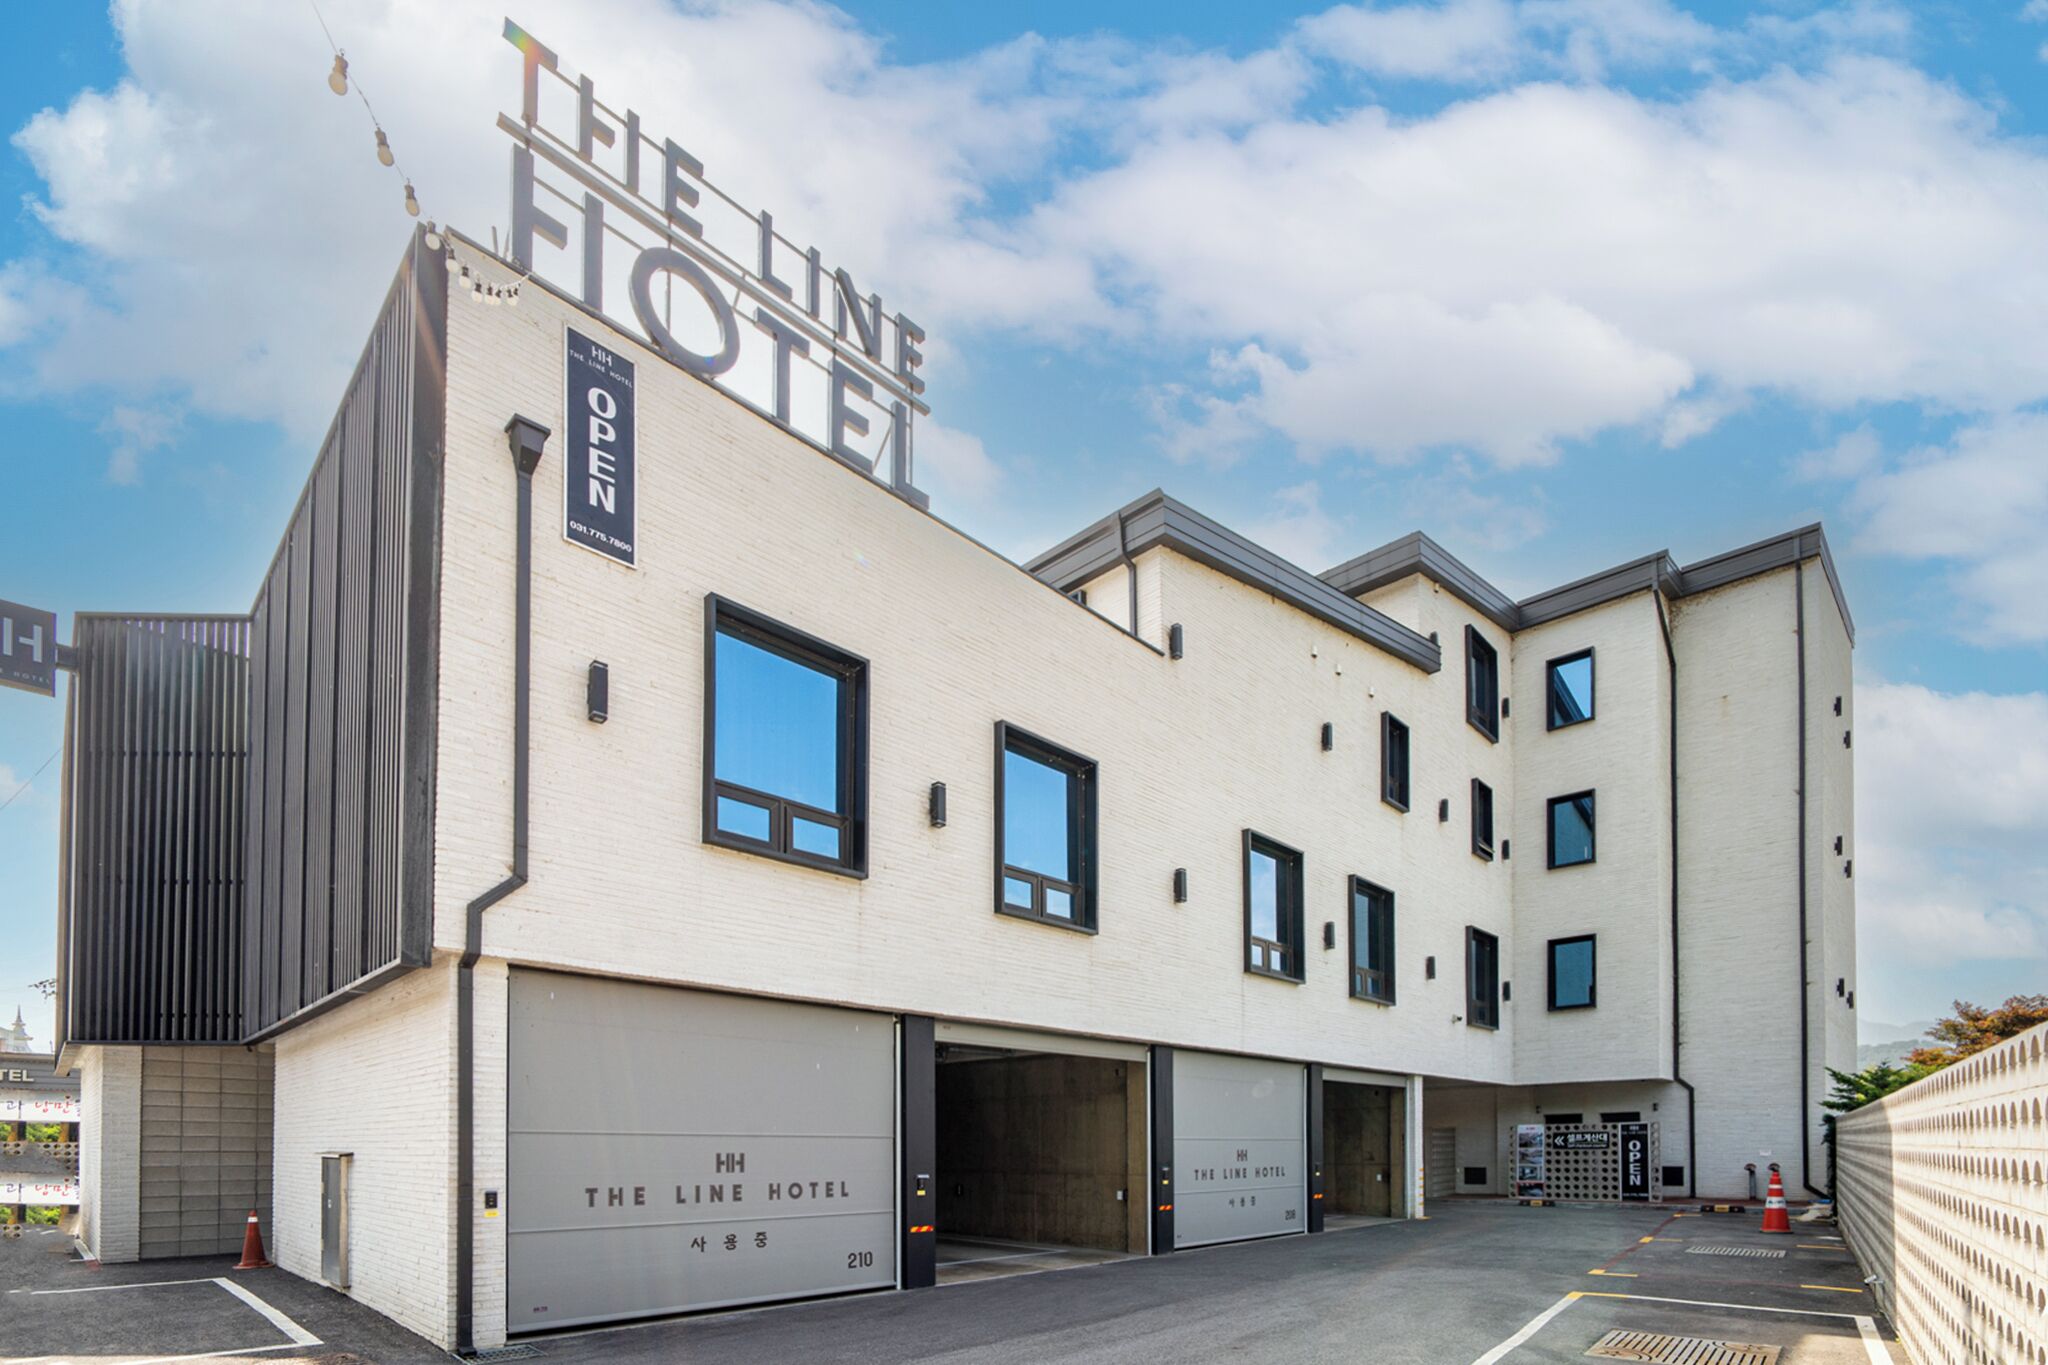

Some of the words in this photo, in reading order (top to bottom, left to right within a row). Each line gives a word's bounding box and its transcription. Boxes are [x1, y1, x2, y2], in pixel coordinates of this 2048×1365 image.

[503, 16, 703, 239] THE
[758, 210, 926, 395] LINE
[511, 143, 930, 510] HOTEL
[570, 349, 584, 362] THE
[589, 359, 605, 373] LINE
[610, 370, 632, 389] HOTEL
[587, 387, 617, 515] OPEN
[1194, 1169, 1214, 1180] THE
[1223, 1167, 1247, 1179] LINE
[1255, 1166, 1285, 1178] HOTEL
[1628, 1140, 1641, 1186] OPEN
[585, 1186, 646, 1207] THE
[676, 1184, 743, 1204] LINE
[768, 1181, 849, 1200] HOTEL
[848, 1251, 873, 1269] 210
